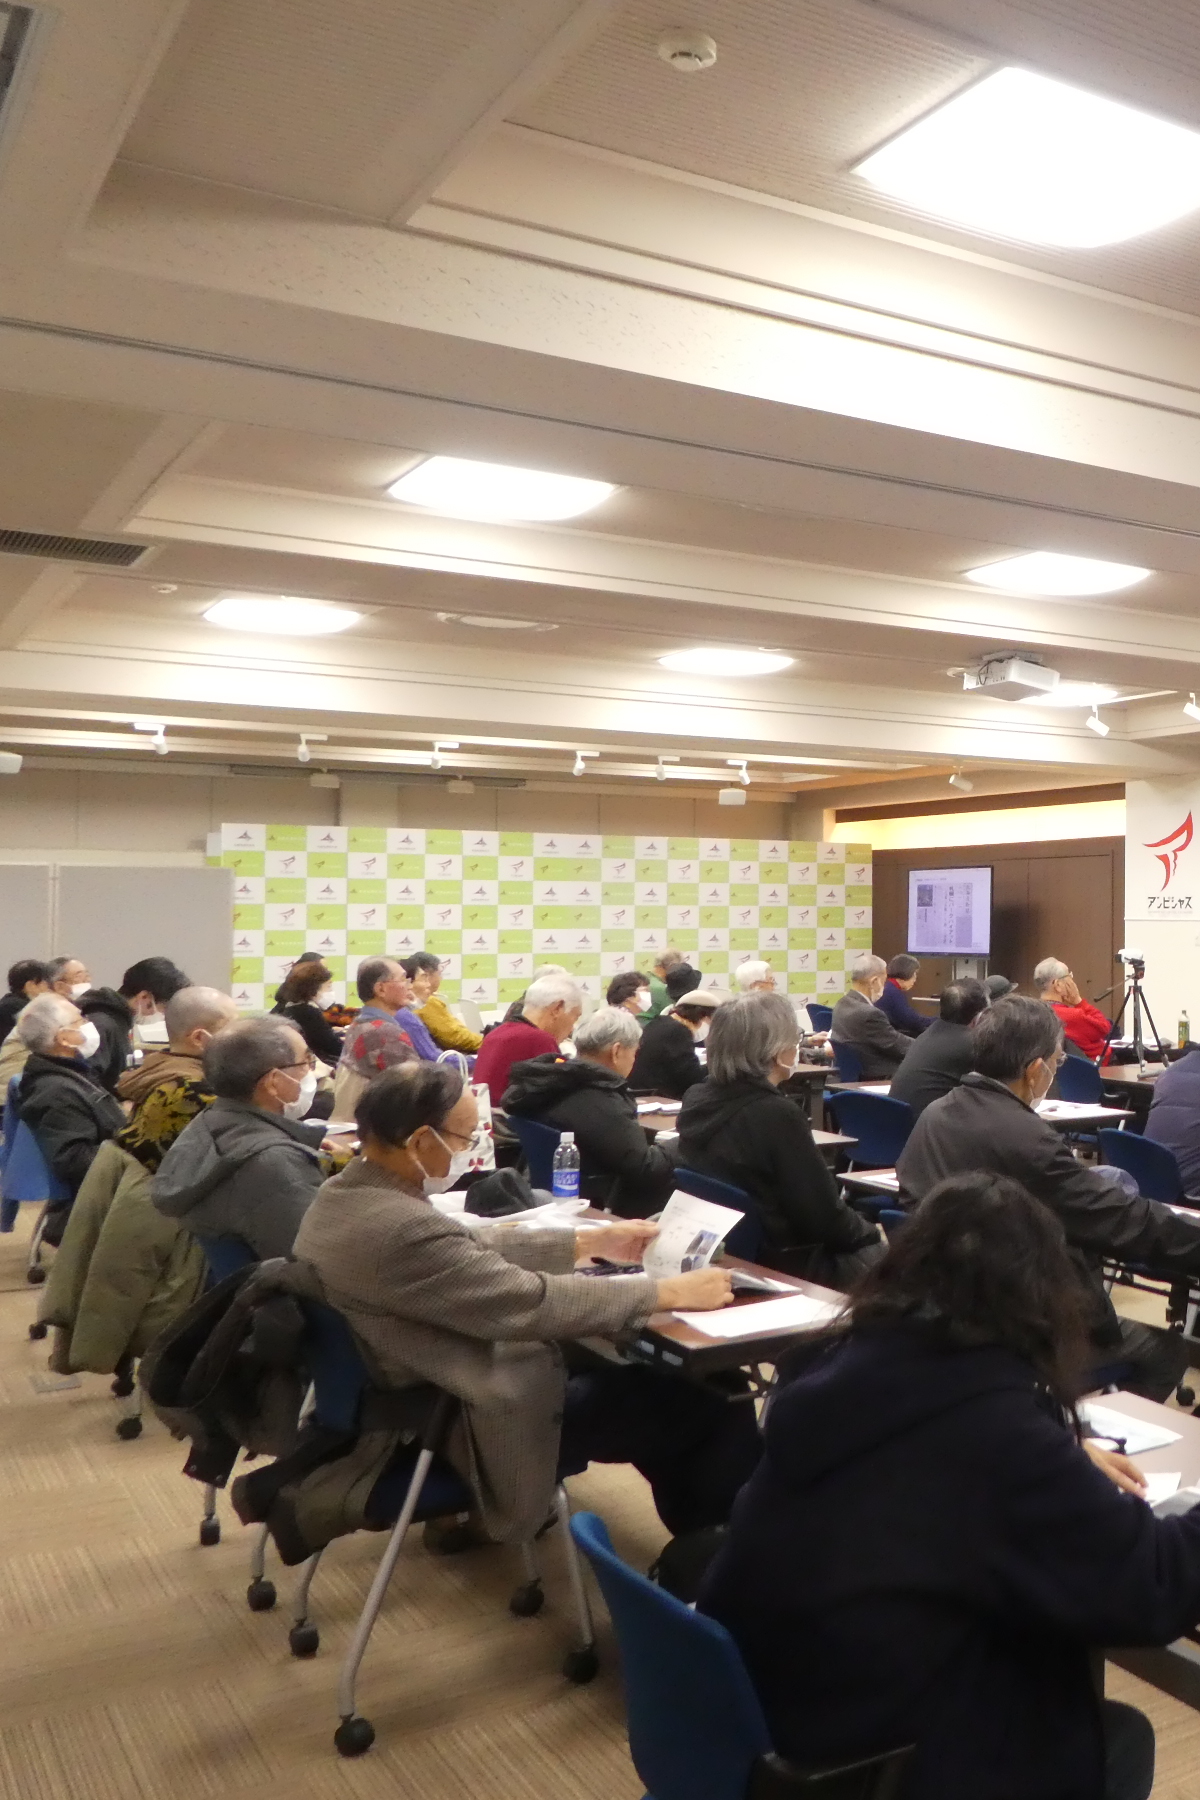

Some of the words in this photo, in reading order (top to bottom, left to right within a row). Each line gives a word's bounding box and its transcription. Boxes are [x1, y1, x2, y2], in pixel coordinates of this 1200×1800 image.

[1147, 896, 1193, 909] アンビシャス
